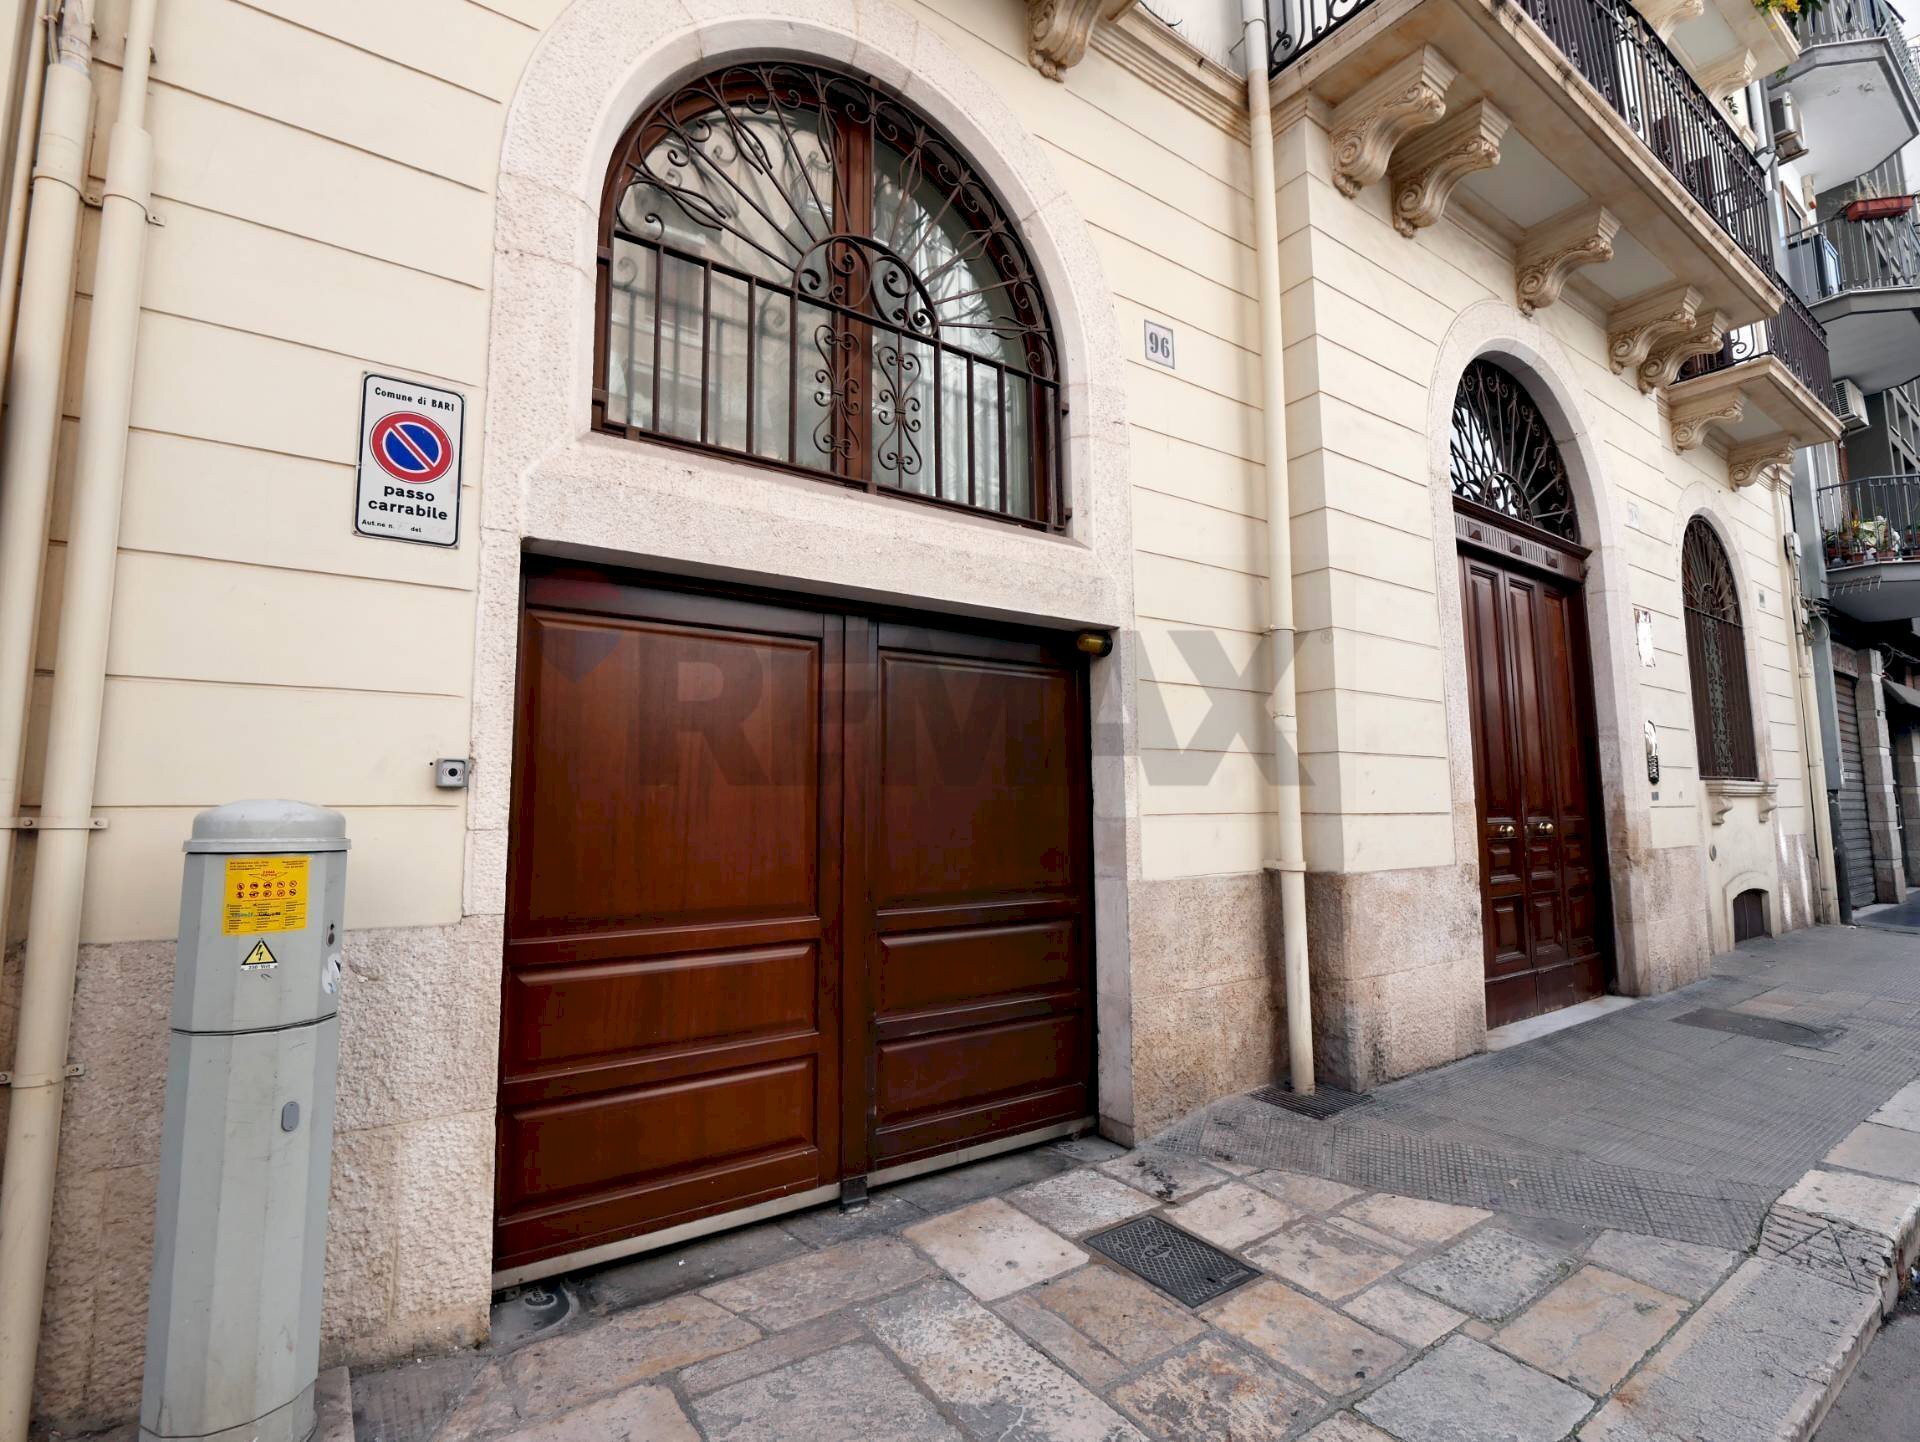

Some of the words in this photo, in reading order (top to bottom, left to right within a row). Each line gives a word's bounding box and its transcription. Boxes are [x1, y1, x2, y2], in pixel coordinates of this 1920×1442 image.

[1149, 332, 1170, 358] 96
[374, 387, 413, 403] Comune
[417, 396, 427, 406] di
[431, 399, 455, 412] BARI
[384, 485, 435, 502] passo
[368, 500, 448, 520] carrabile
